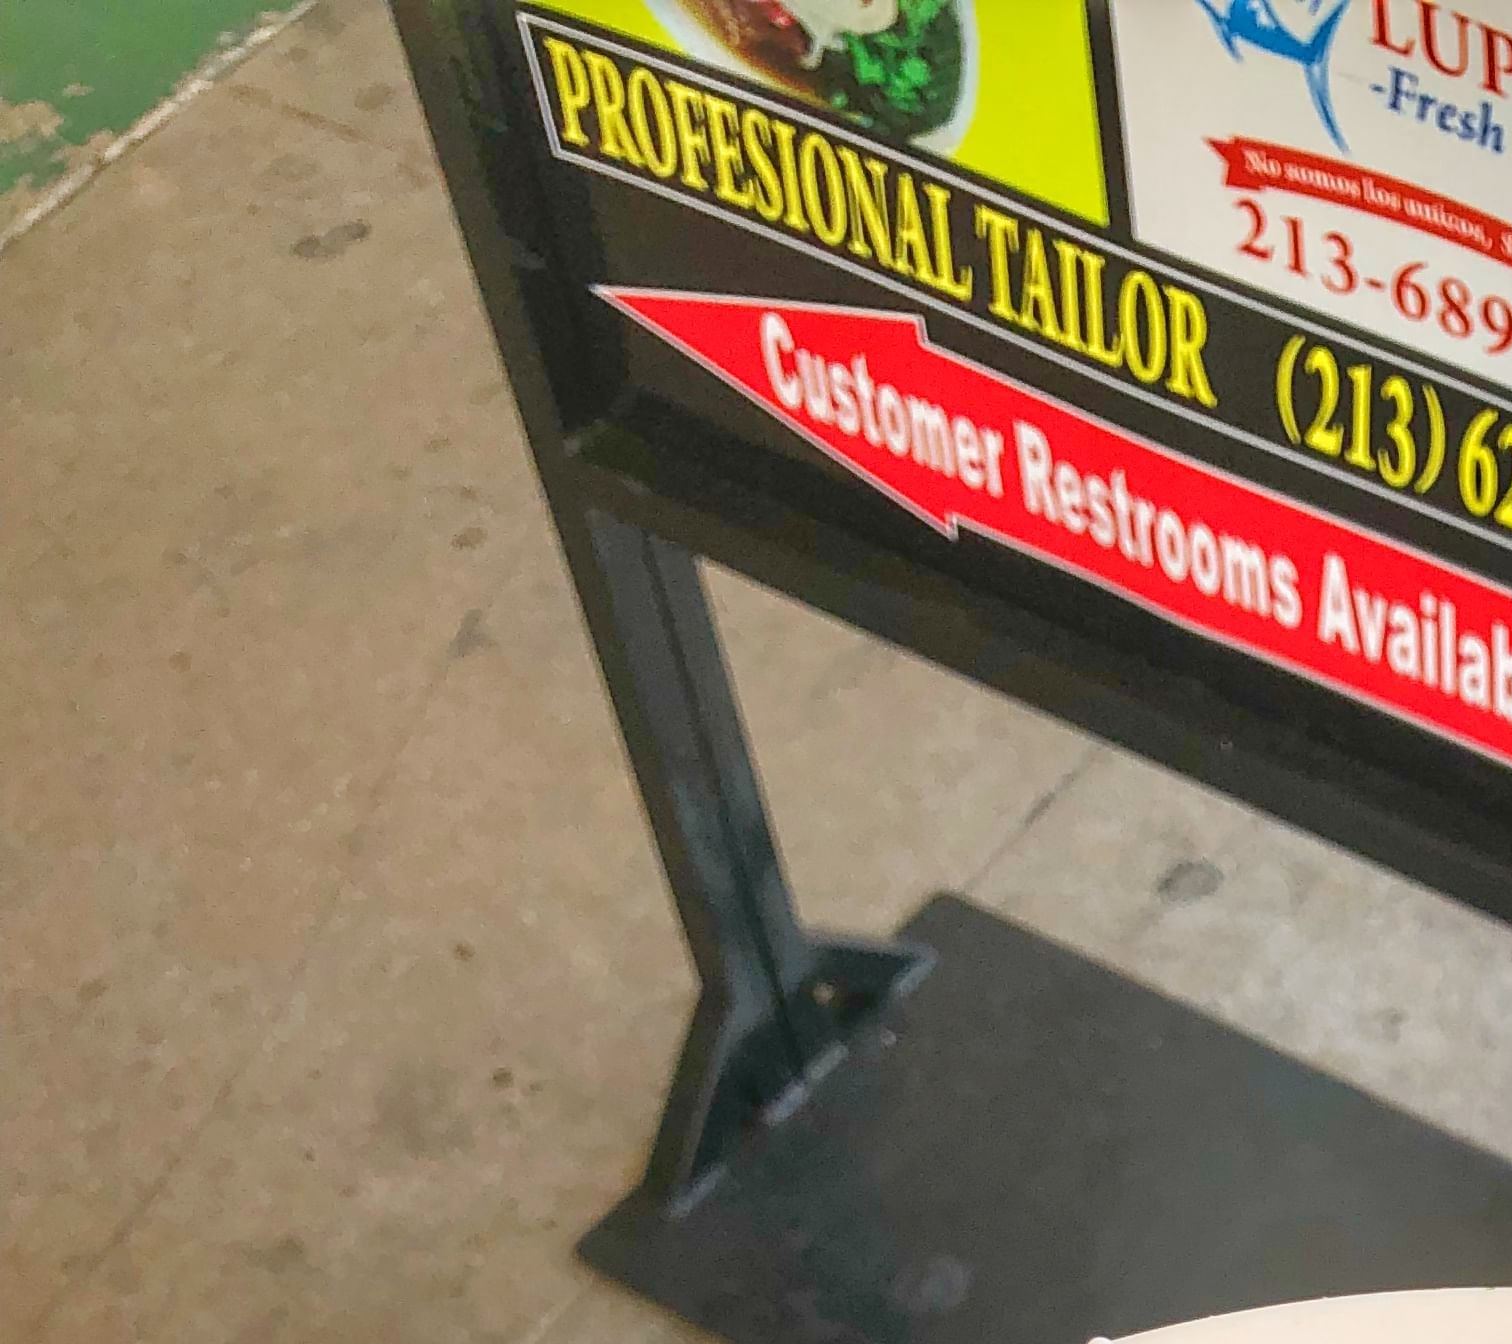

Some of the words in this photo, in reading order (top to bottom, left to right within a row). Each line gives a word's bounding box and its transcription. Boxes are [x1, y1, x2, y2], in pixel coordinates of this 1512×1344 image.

[544, 36, 973, 300] PROFESIONAL
[975, 204, 1218, 409] TAILOR
[1276, 335, 1446, 494] (213)
[759, 311, 1005, 498] Customer
[1013, 419, 1303, 629] Restrooms
